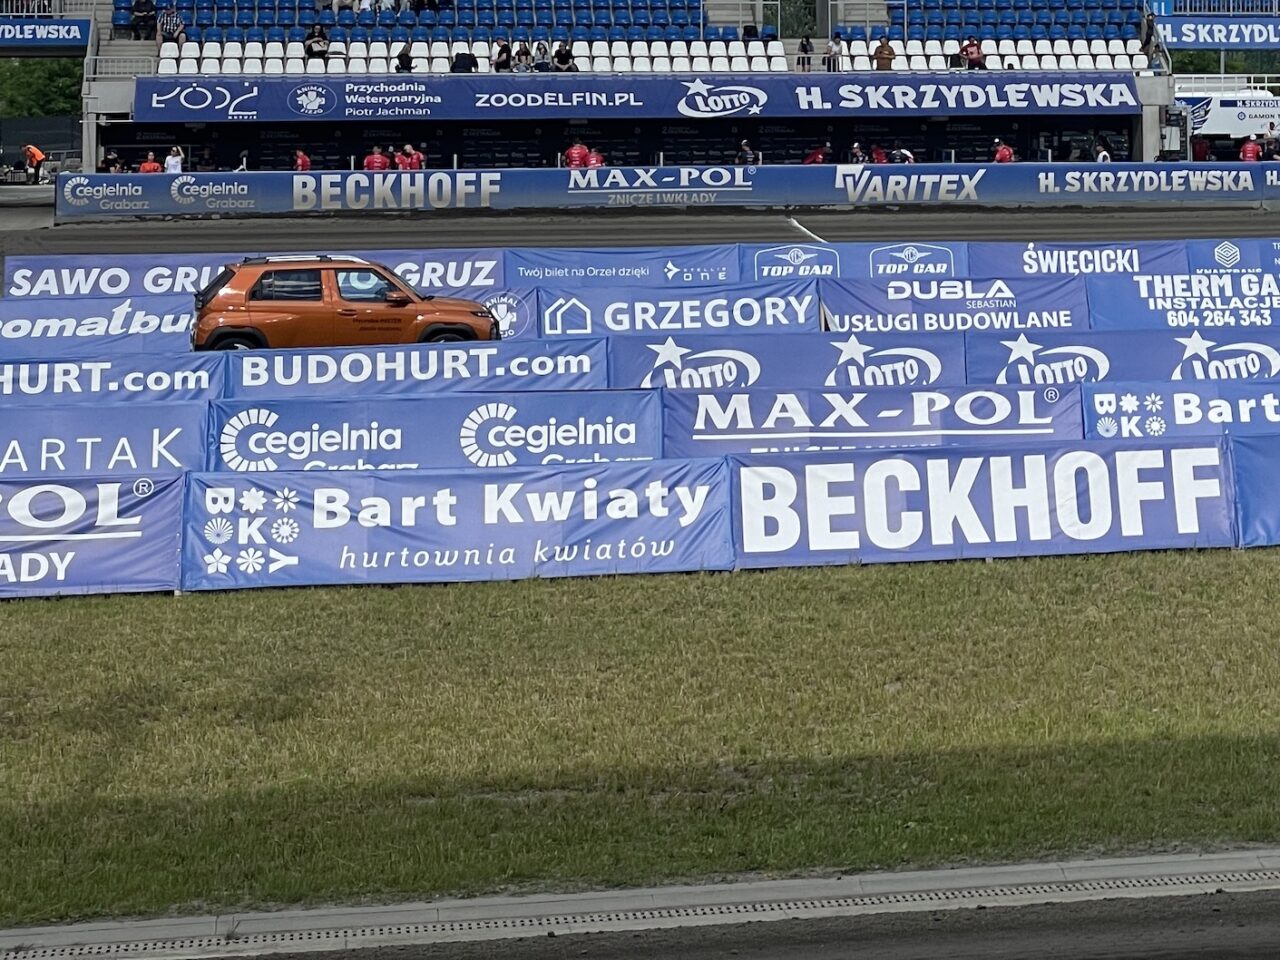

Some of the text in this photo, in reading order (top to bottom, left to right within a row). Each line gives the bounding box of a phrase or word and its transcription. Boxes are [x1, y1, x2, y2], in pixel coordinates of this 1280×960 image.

[1157, 24, 1178, 42] H.
[345, 82, 426, 95] Przychodnia
[795, 83, 1138, 110] H. SKRZYDLEWSKA
[345, 93, 442, 106] Weterynaryjna
[475, 93, 644, 108] ZOODELFIN.PL
[694, 93, 751, 112] LOTTO
[346, 106, 431, 117] Piotr Jachman
[76, 182, 143, 198] cegielnia
[182, 181, 249, 197] cegielnia
[293, 172, 502, 210] BECKHOFF
[843, 168, 987, 202] VARITEX
[1038, 169, 1254, 193] H. SKRZYDLEWSKA
[100, 199, 150, 210] Grabarz
[206, 198, 255, 209] Grabarz
[608, 194, 654, 206] ZNICZE
[663, 192, 718, 205] WKŁADY
[877, 263, 948, 275] TOP CAR
[1022, 242, 1141, 276] ŚWIĘCICKI
[394, 260, 497, 289] GRUZ
[518, 265, 650, 278] Twój bilet na Orzeł dzięki
[761, 264, 834, 276] TOP CAR
[10, 266, 131, 297] SAWO
[887, 280, 1016, 300] DUBLA
[1133, 274, 1232, 298] THERM
[486, 296, 518, 308] ANIMAL
[966, 299, 1017, 309] SEBASTIAN
[0, 299, 195, 338] omatbu
[604, 295, 813, 331] GRZEGORY
[834, 310, 1072, 332] USŁUGI BUDOWLANE
[1167, 310, 1272, 328] 604 264 343
[242, 348, 591, 387] BUDOHURT.com
[248, 420, 403, 460] cegielnia
[486, 414, 638, 455] cegielnia
[313, 477, 710, 530] Bart Kwiaty
[740, 446, 1222, 554] BECKHOFF
[340, 538, 676, 570] hurtownia kwiatów
